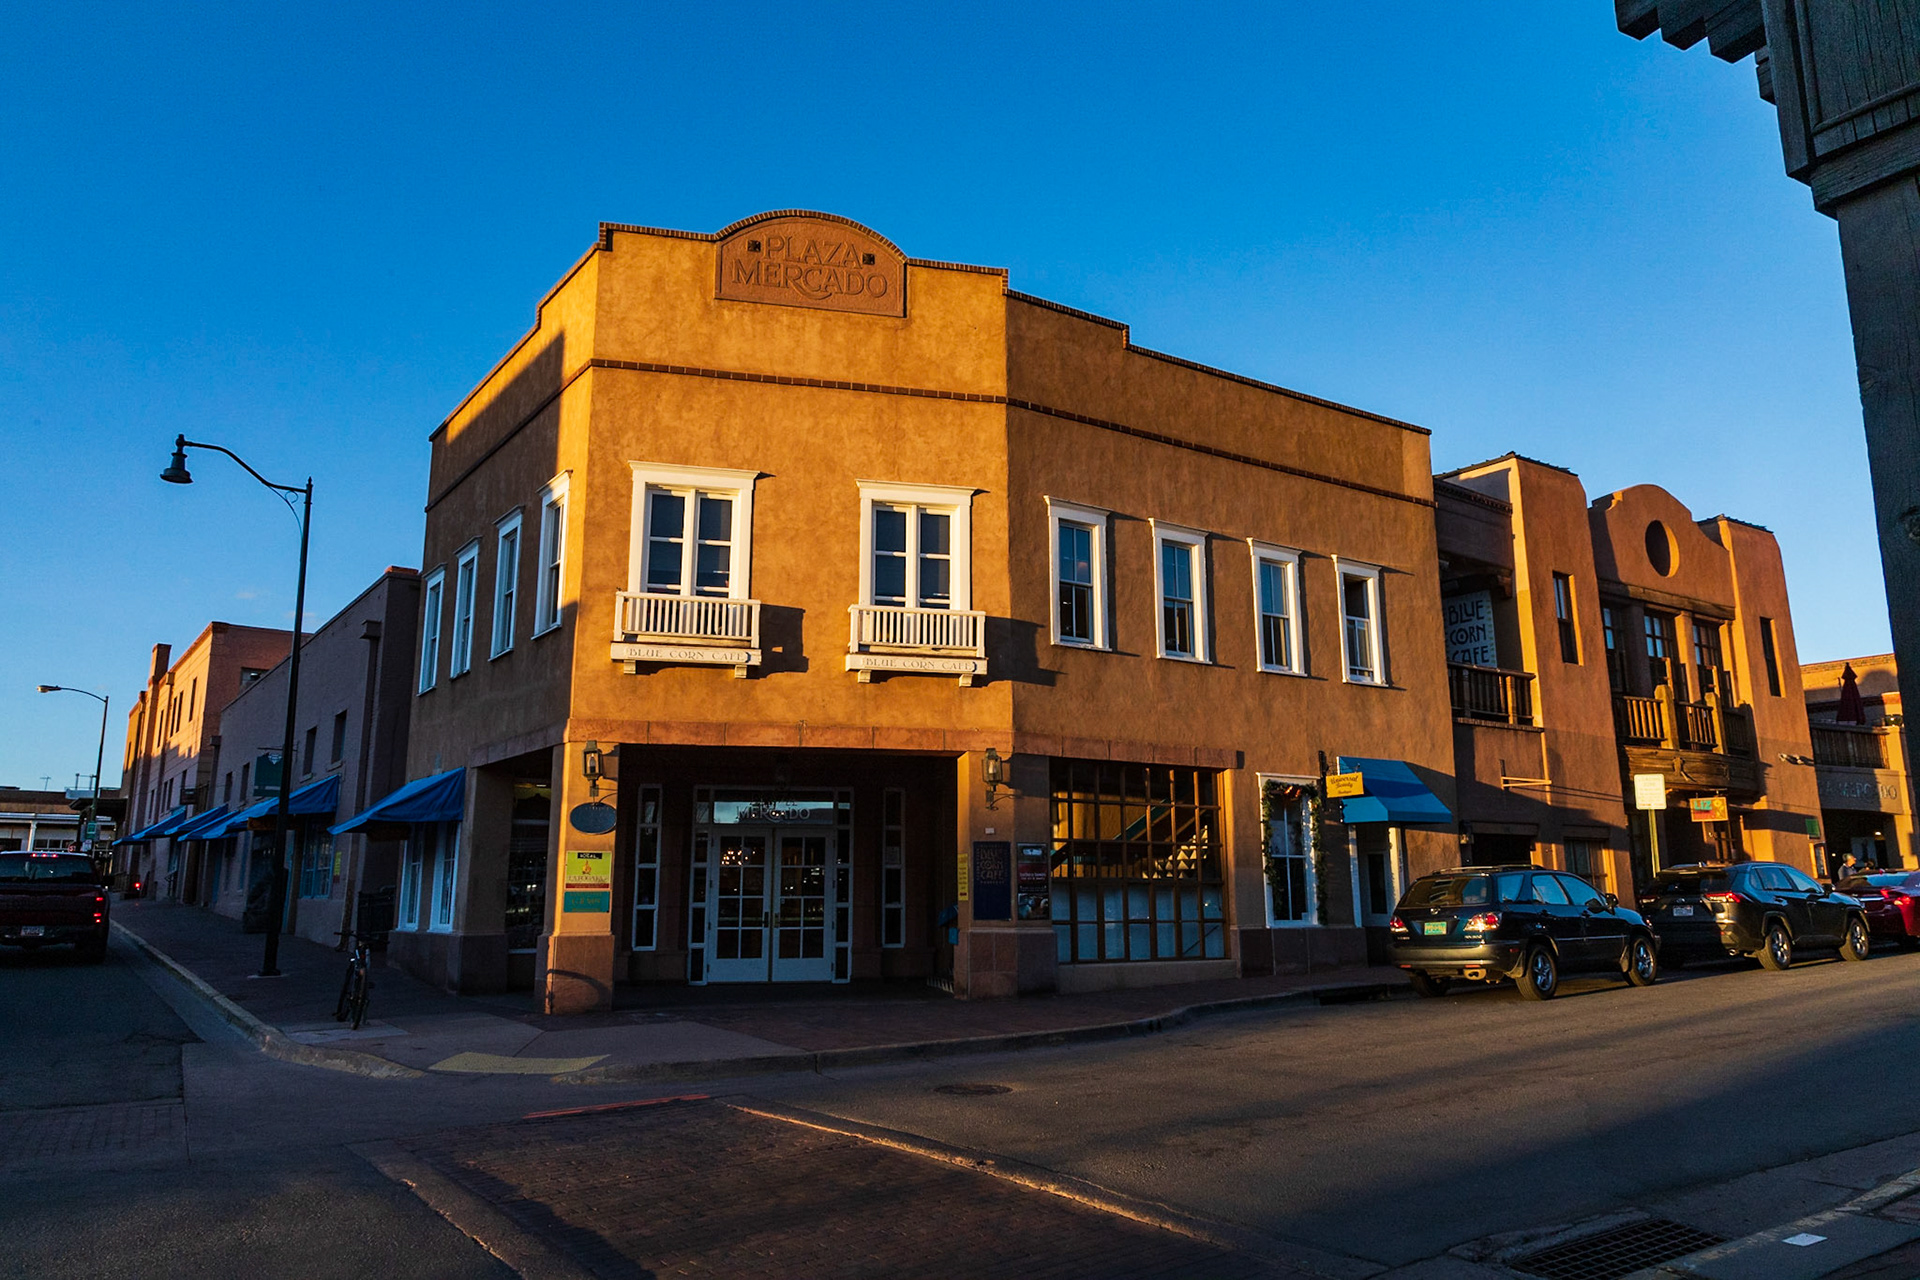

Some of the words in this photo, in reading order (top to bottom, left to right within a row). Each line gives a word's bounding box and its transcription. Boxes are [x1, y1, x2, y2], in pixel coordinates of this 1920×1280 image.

[763, 234, 864, 270] PLAZA
[732, 258, 888, 300] MERCADO
[1448, 599, 1485, 626] BLUE
[1449, 624, 1488, 646] CORN
[628, 648, 663, 659] BLUE
[669, 650, 705, 660] CORN
[711, 651, 745, 661] CAFE
[865, 657, 897, 668] BLUE
[902, 659, 935, 670] CORN
[941, 661, 973, 671] CAFE
[1694, 799, 1713, 811] LIZ
